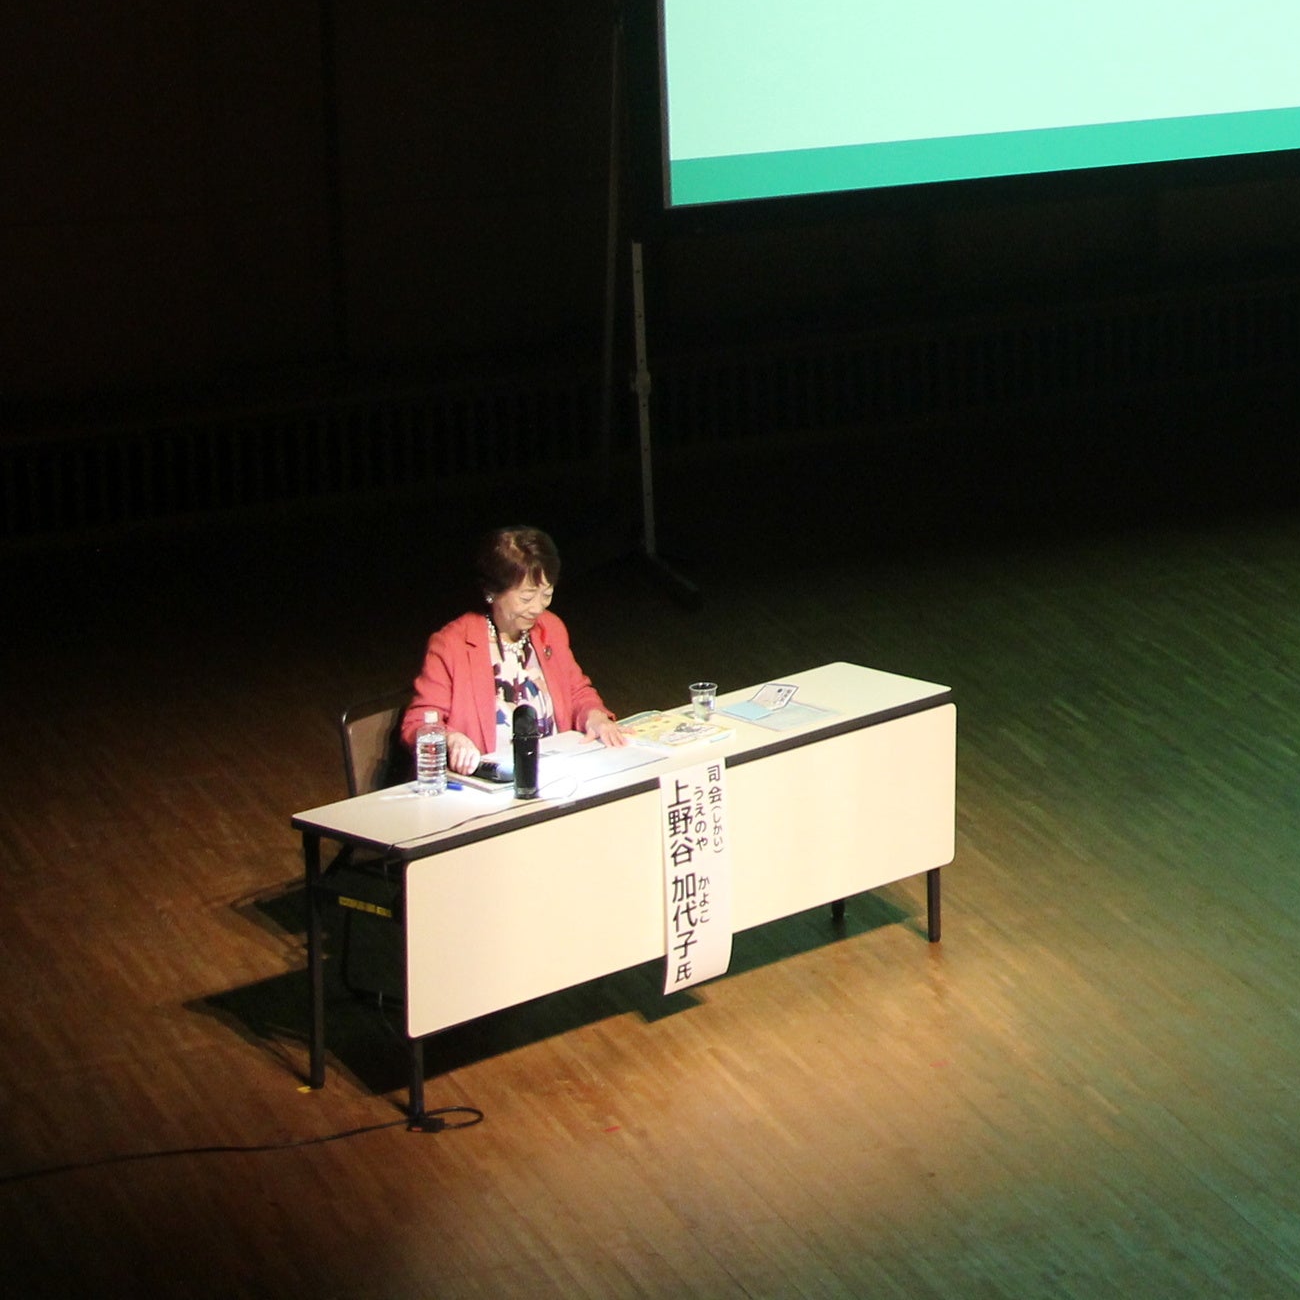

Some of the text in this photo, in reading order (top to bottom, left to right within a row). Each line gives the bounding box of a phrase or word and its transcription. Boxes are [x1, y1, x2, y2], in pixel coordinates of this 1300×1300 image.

[694, 786, 710, 924] うえのや かよこ
